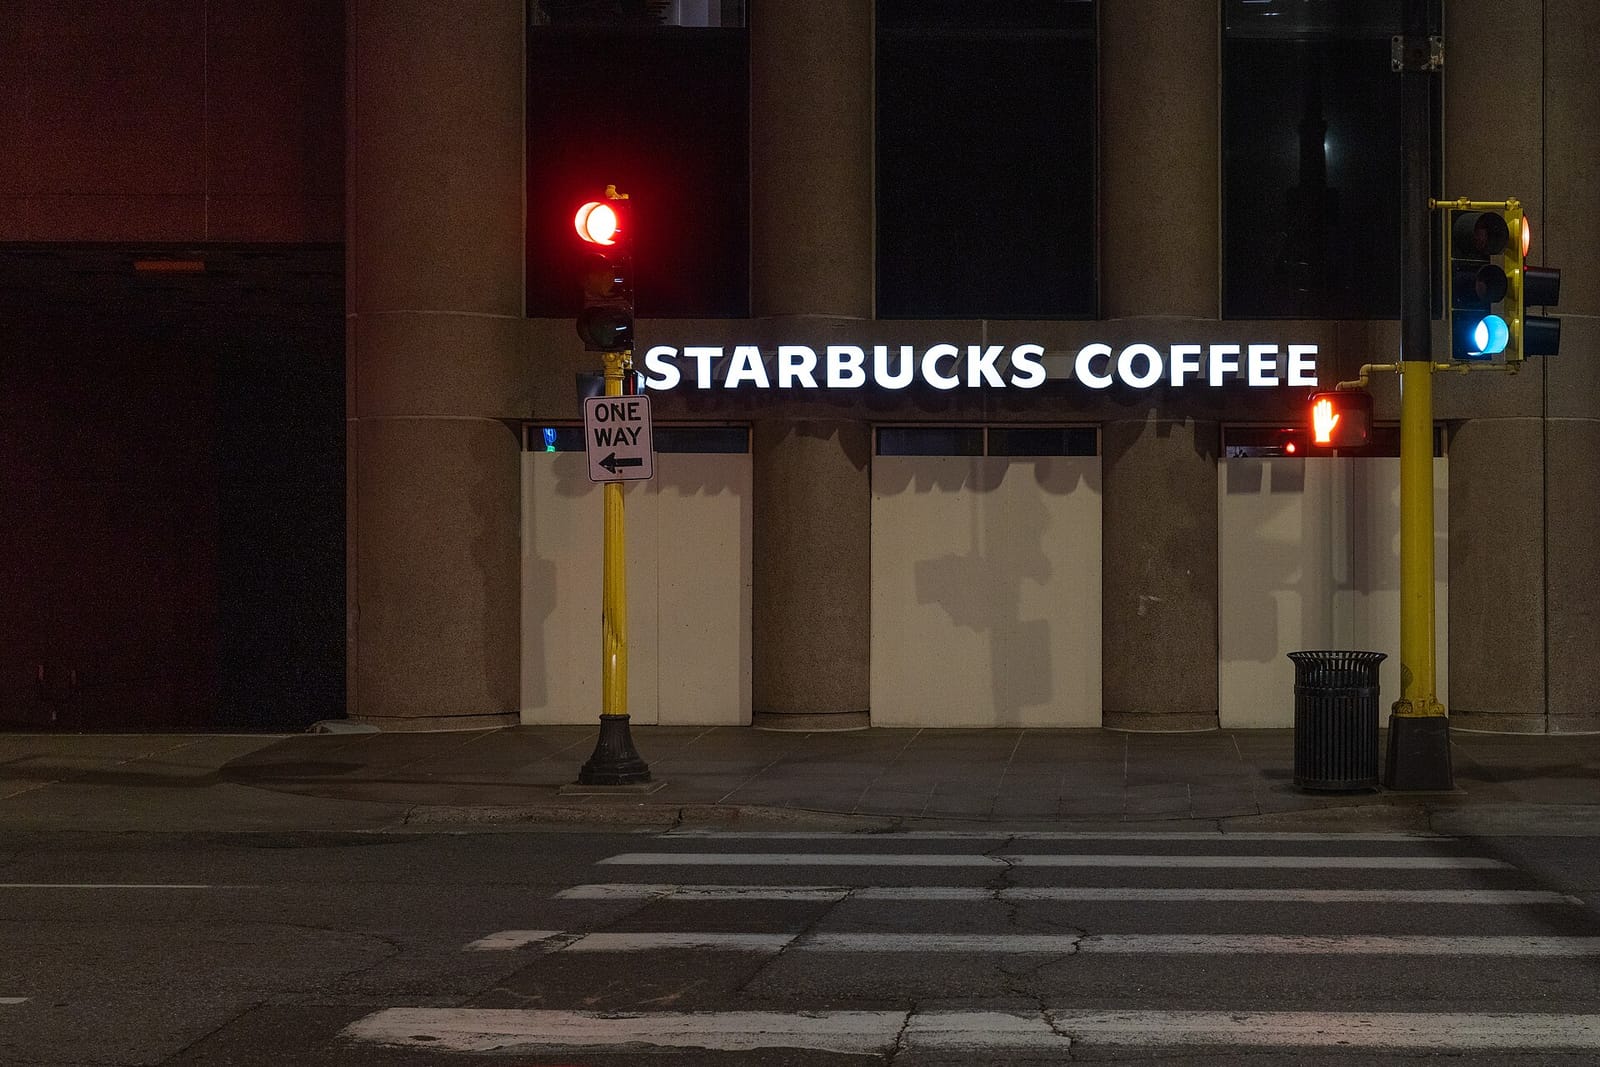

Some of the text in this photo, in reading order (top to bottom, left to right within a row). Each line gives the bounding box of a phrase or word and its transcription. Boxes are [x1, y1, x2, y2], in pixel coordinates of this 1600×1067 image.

[645, 343, 1319, 390] STARBUCKS COFFEE
[594, 402, 642, 422] ONE
[594, 426, 642, 447] WAY
